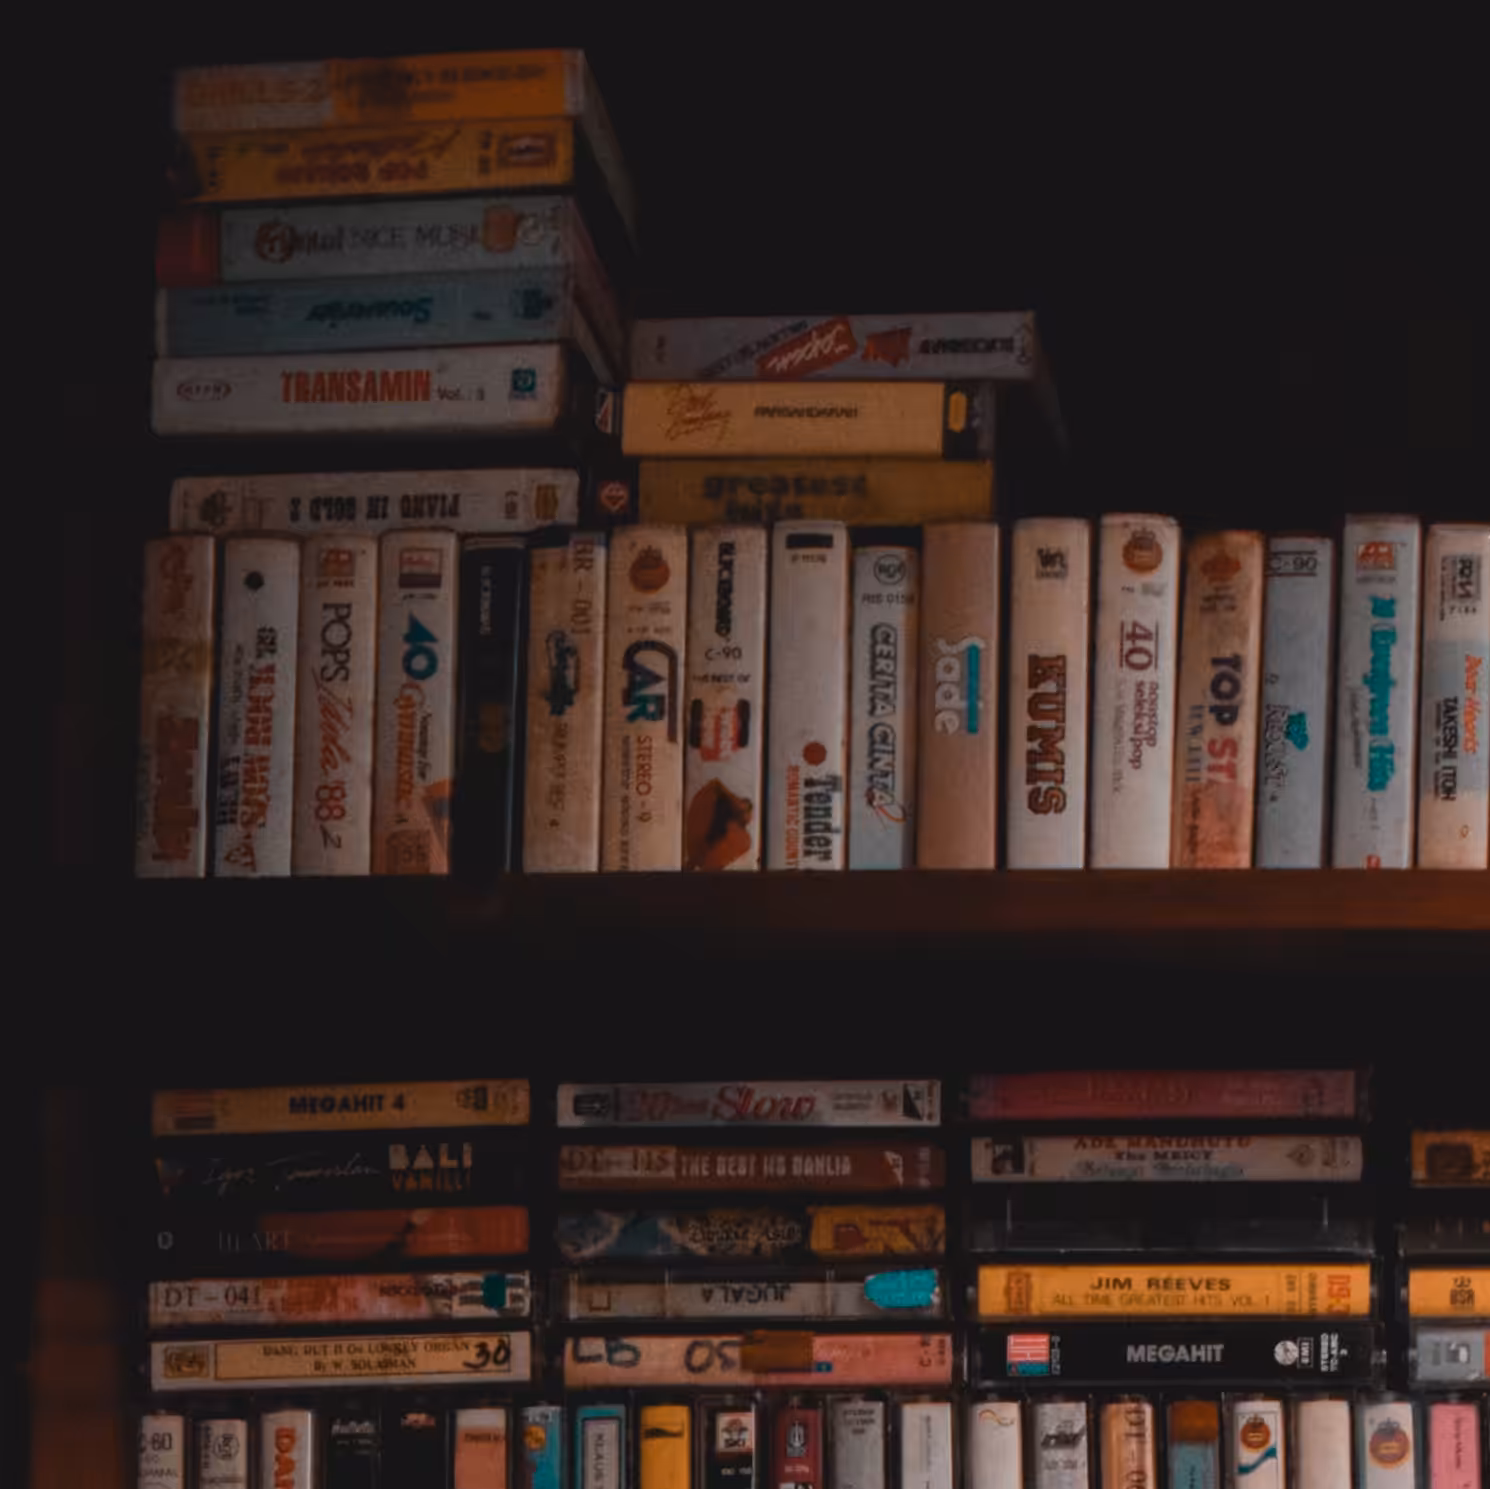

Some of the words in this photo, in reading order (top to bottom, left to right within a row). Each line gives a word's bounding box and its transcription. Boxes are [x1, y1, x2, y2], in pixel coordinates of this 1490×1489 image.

[281, 370, 431, 402] TRANSAMIN
[320, 602, 352, 682] POPS
[866, 624, 897, 717] CERITA
[936, 638, 985, 735] Sade
[866, 723, 897, 808] CINTA
[1026, 655, 1067, 815] KUMIS
[803, 775, 842, 861] Tender
[289, 1094, 383, 1114] MEGAHIT
[392, 1094, 405, 1114] 4
[1090, 1277, 1131, 1291] JIM
[1147, 1277, 1230, 1291] REEVES
[1126, 1345, 1224, 1363] MEGAHIT
